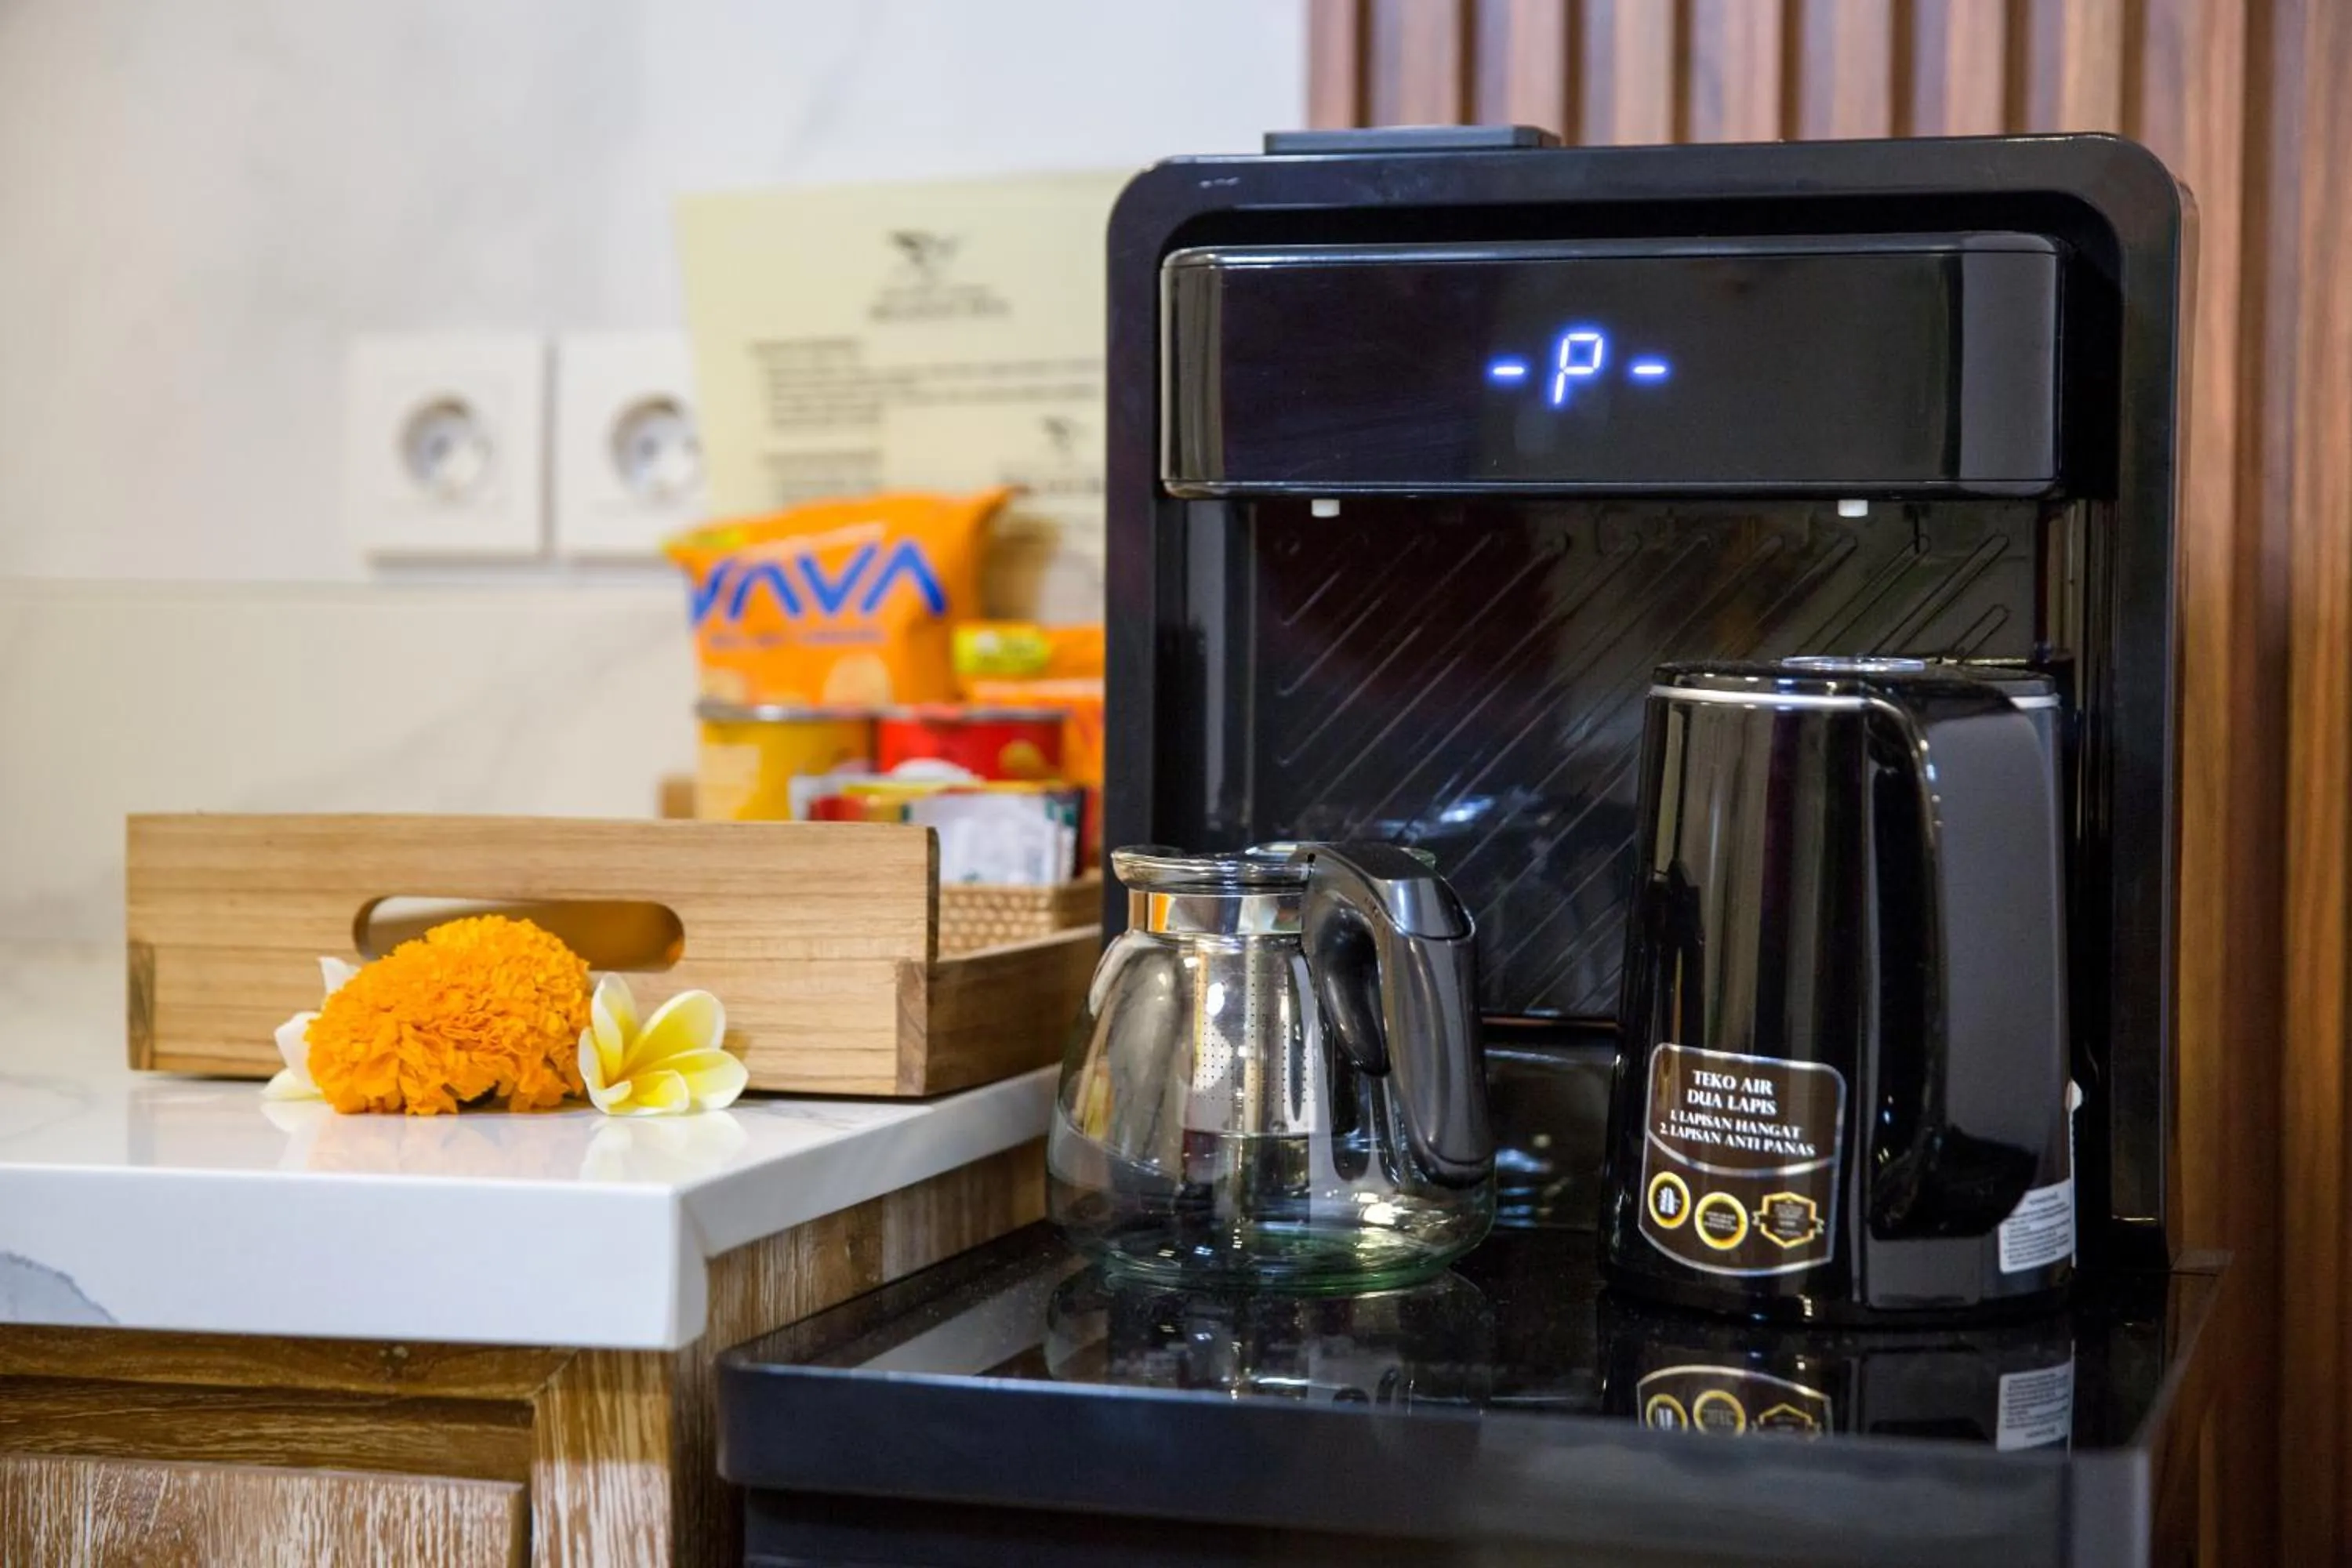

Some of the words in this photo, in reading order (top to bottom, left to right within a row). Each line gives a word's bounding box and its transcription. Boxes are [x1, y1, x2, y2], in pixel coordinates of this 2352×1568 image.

[1693, 1070, 1737, 1090] TEKO
[1740, 1077, 1773, 1095] AIR
[1687, 1089, 1722, 1108] DUA
[1727, 1095, 1777, 1115] LAPIS
[1680, 1110, 1732, 1130] LAPISAN
[1735, 1119, 1802, 1139] HANGAT
[1671, 1124, 1721, 1144] LAPISAN
[1725, 1134, 1760, 1150] ANTI
[1762, 1140, 1816, 1156] PANAS
